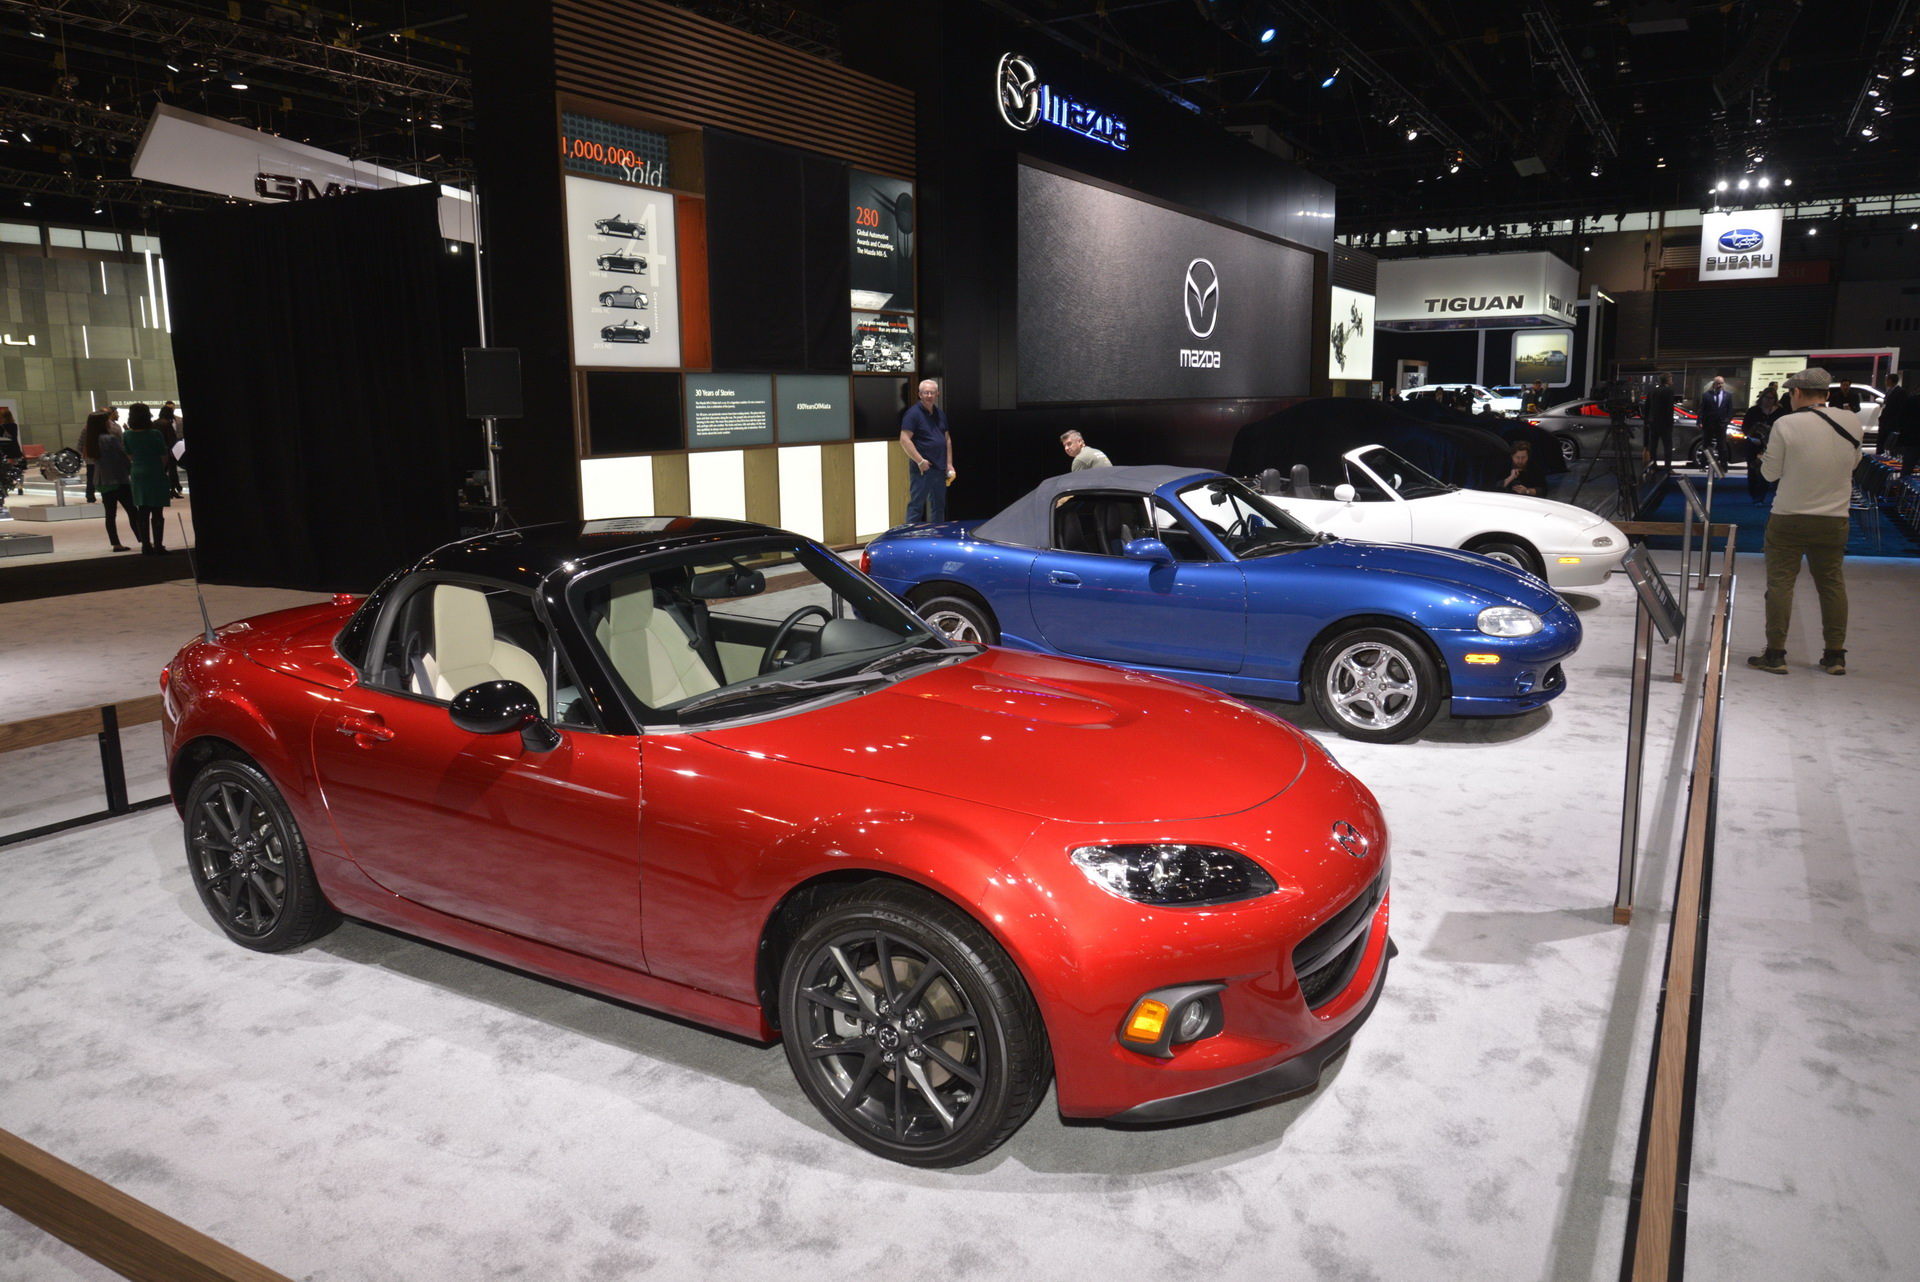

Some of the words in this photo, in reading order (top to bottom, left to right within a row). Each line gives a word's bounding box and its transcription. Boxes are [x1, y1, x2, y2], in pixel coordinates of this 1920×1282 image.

[562, 136, 644, 168] 1,000,000+
[619, 157, 663, 187] Sold
[856, 206, 879, 228] 280
[856, 228, 869, 237] Global
[869, 231, 889, 241] Automotive
[856, 238, 870, 246] Awards
[624, 203, 666, 287] 4
[856, 246, 864, 254] The
[863, 248, 876, 256] Mazda
[1706, 253, 1774, 265] SUBARU
[1424, 294, 1525, 313] TIGUAN
[1180, 348, 1221, 369] mazda
[695, 389, 702, 397] 30
[702, 389, 714, 397] Years
[714, 389, 720, 397] of
[720, 389, 735, 397] Stories
[796, 402, 831, 410] #30YearsOfMiata
